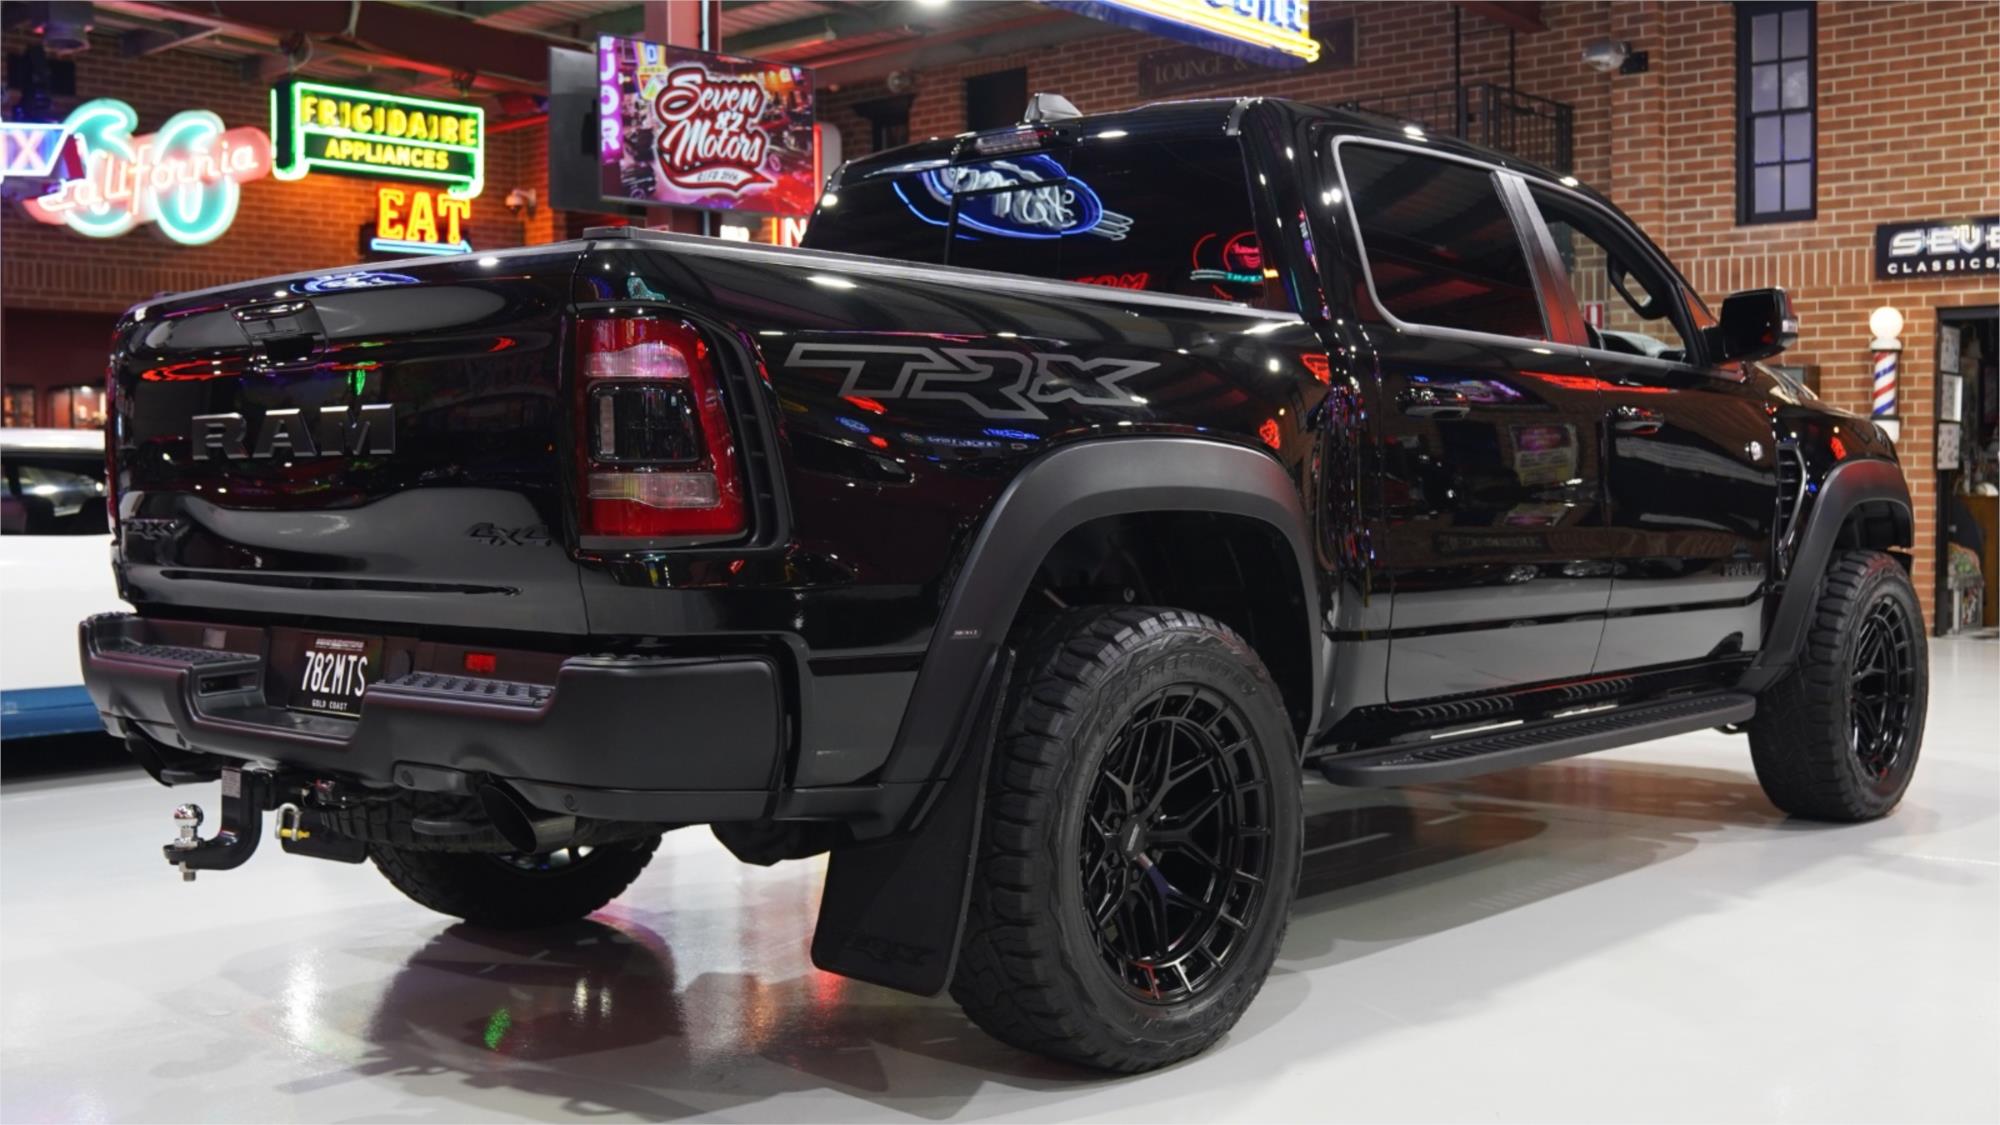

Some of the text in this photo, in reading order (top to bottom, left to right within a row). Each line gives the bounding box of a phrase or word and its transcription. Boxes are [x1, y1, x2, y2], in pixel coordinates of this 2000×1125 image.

[301, 94, 479, 149] FRIGIDAIRE
[658, 73, 759, 121] Seven
[323, 137, 450, 172] APPLIANCES
[661, 117, 763, 168] Motors
[376, 187, 472, 246] EAT
[783, 342, 1162, 420] TRX
[191, 403, 397, 461] RAM
[301, 650, 369, 697] 782MTS
[311, 699, 348, 711] GOLD COAST
